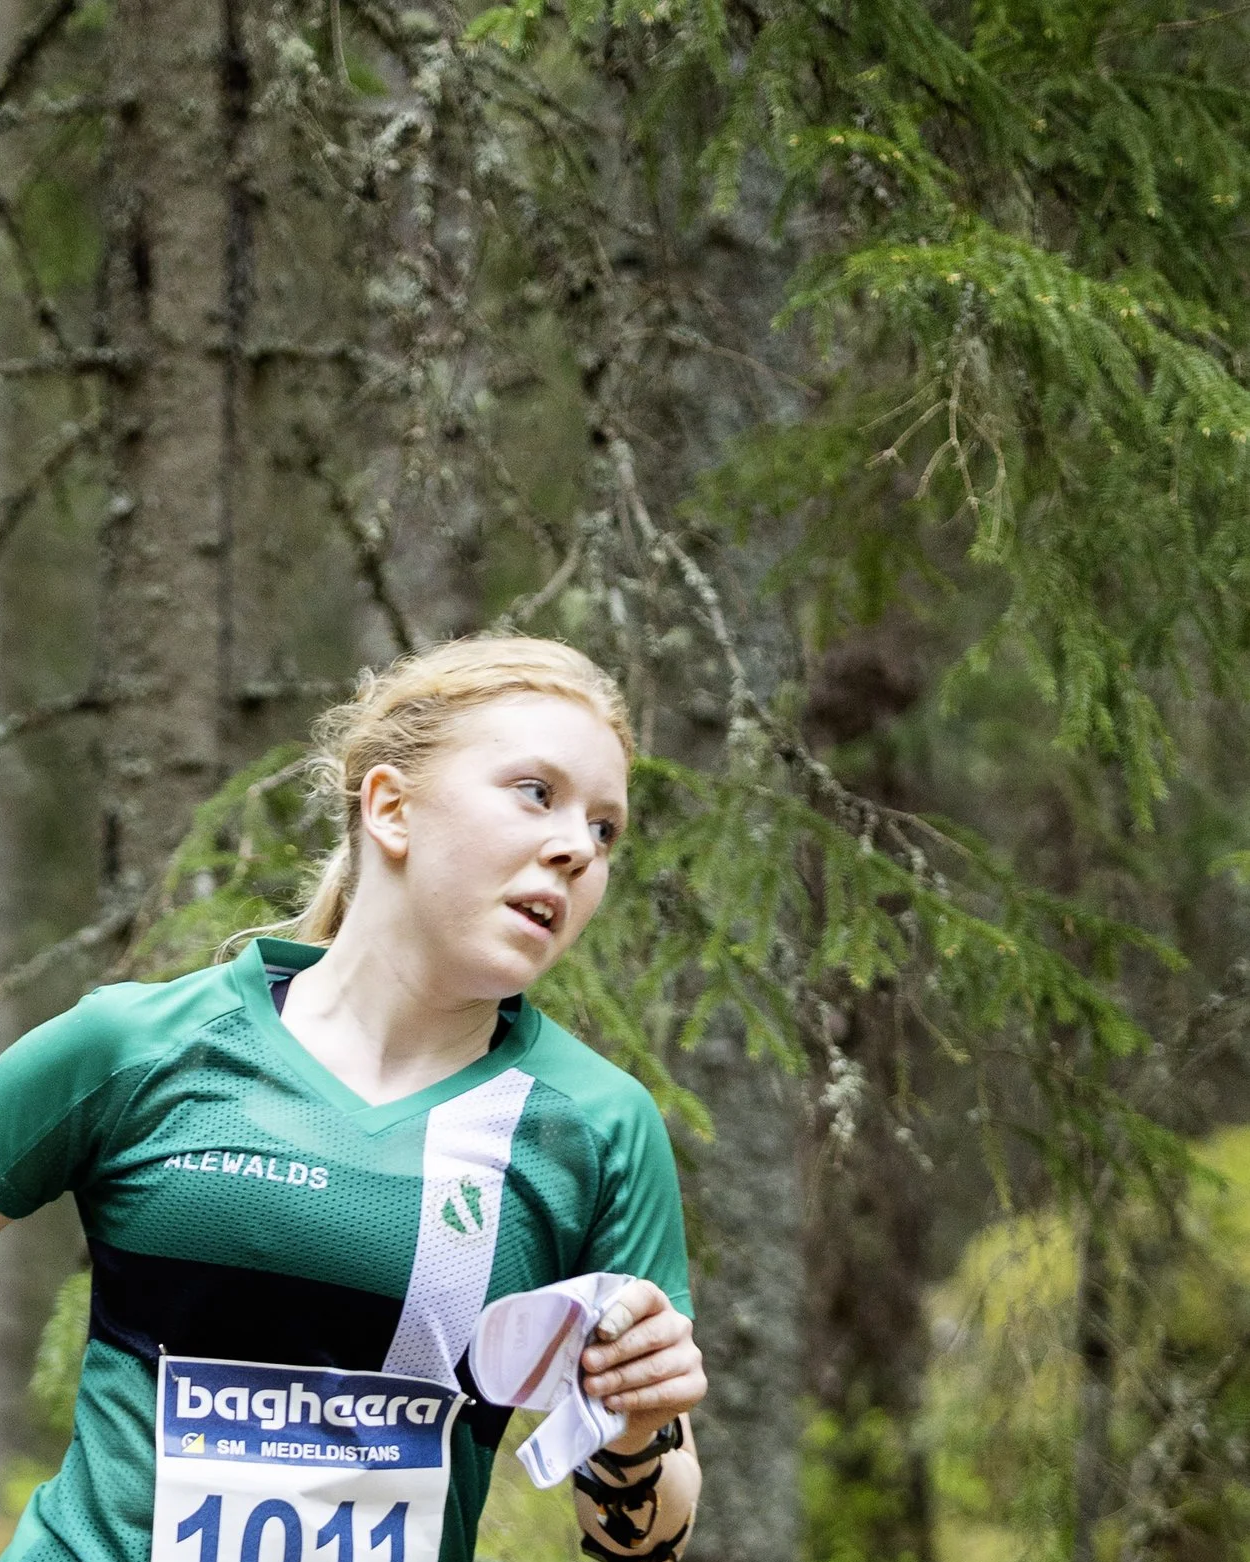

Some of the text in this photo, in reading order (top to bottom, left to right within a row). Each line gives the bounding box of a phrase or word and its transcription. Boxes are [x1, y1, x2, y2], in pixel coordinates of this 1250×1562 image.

[177, 1376, 442, 1430] bagheera
[217, 1440, 400, 1462] SM MEDELDISTANS
